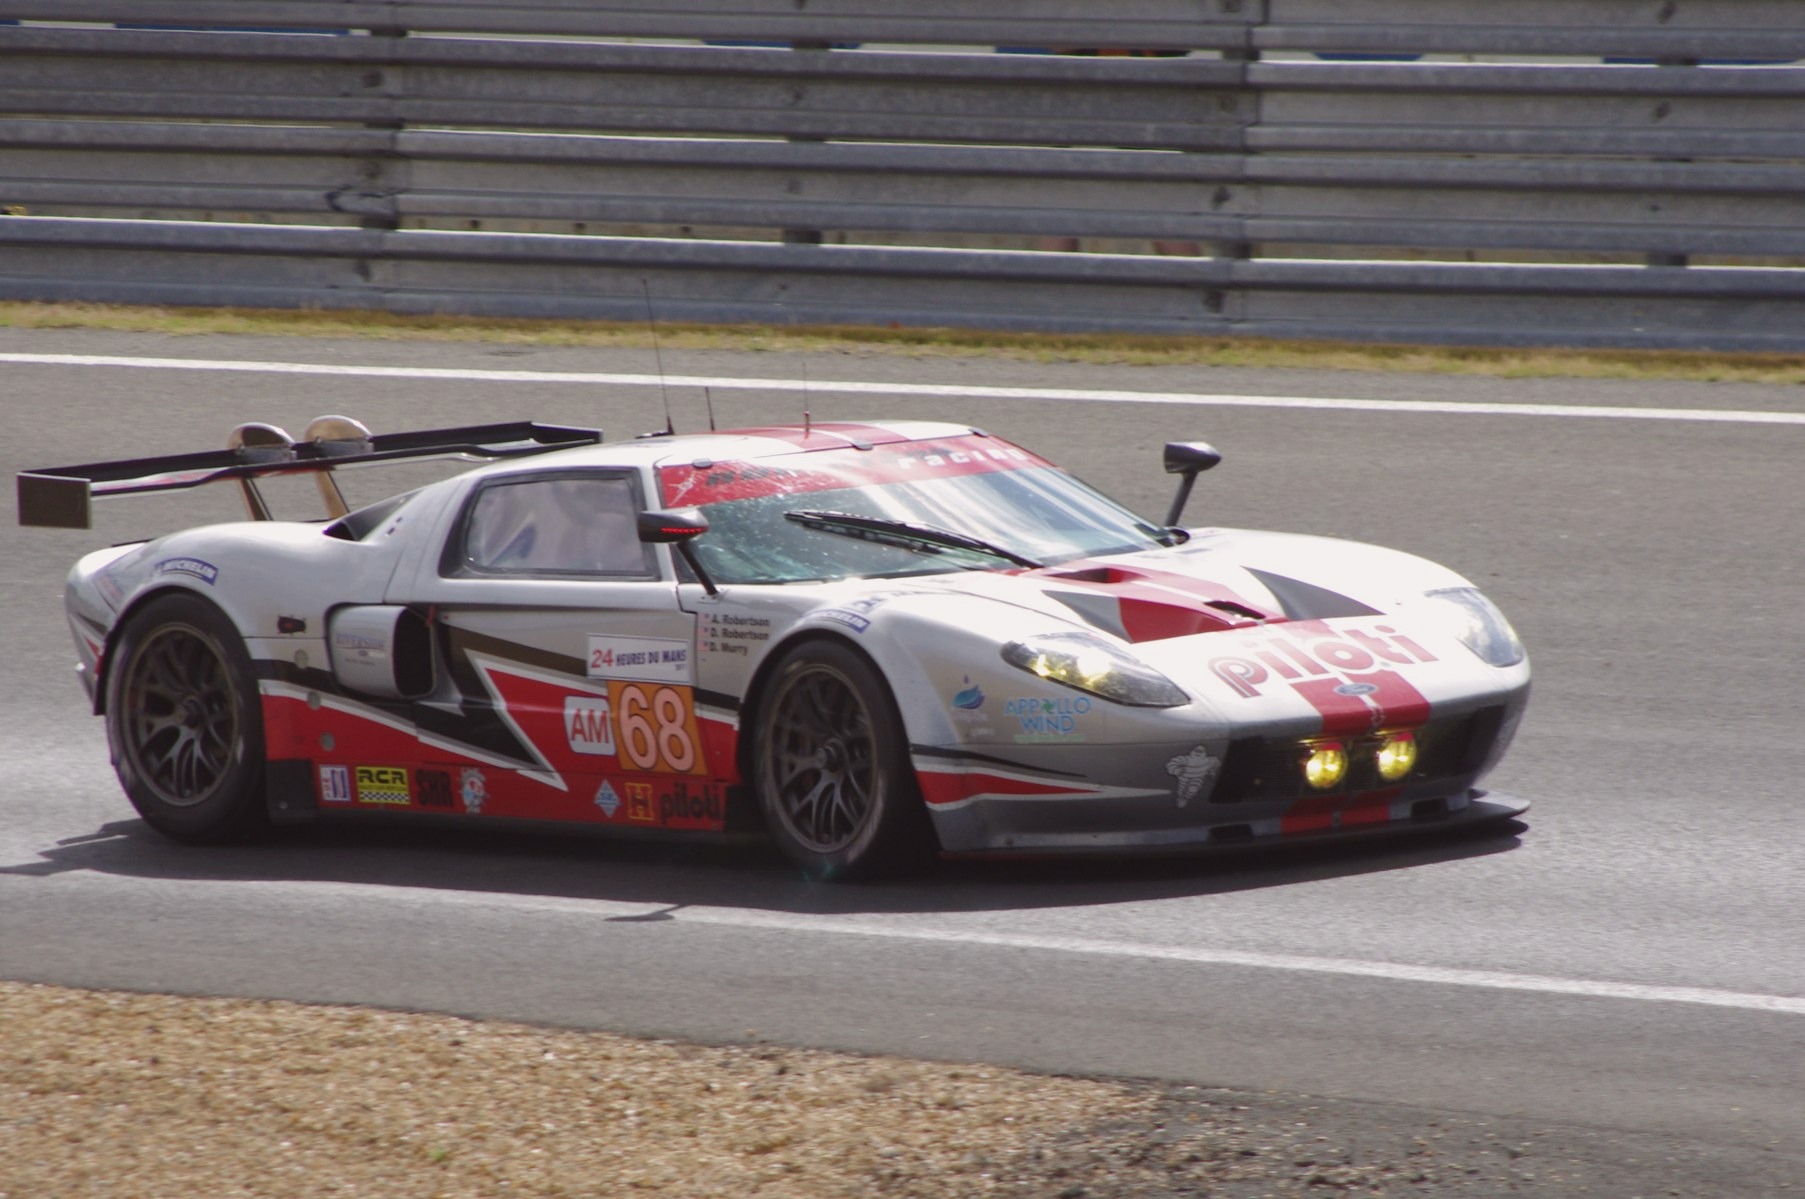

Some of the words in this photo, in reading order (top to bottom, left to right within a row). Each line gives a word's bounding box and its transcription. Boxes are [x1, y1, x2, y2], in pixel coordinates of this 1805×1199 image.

[590, 648, 614, 669] 24
[616, 652, 646, 666] HEURES
[648, 651, 660, 664] DU
[662, 649, 687, 663] MANS
[1207, 624, 1440, 699] piloti
[570, 708, 610, 744] AM
[619, 684, 695, 772] 68
[1020, 715, 1076, 732] WIND
[358, 769, 406, 785] RCR
[659, 780, 721, 826] piloti
